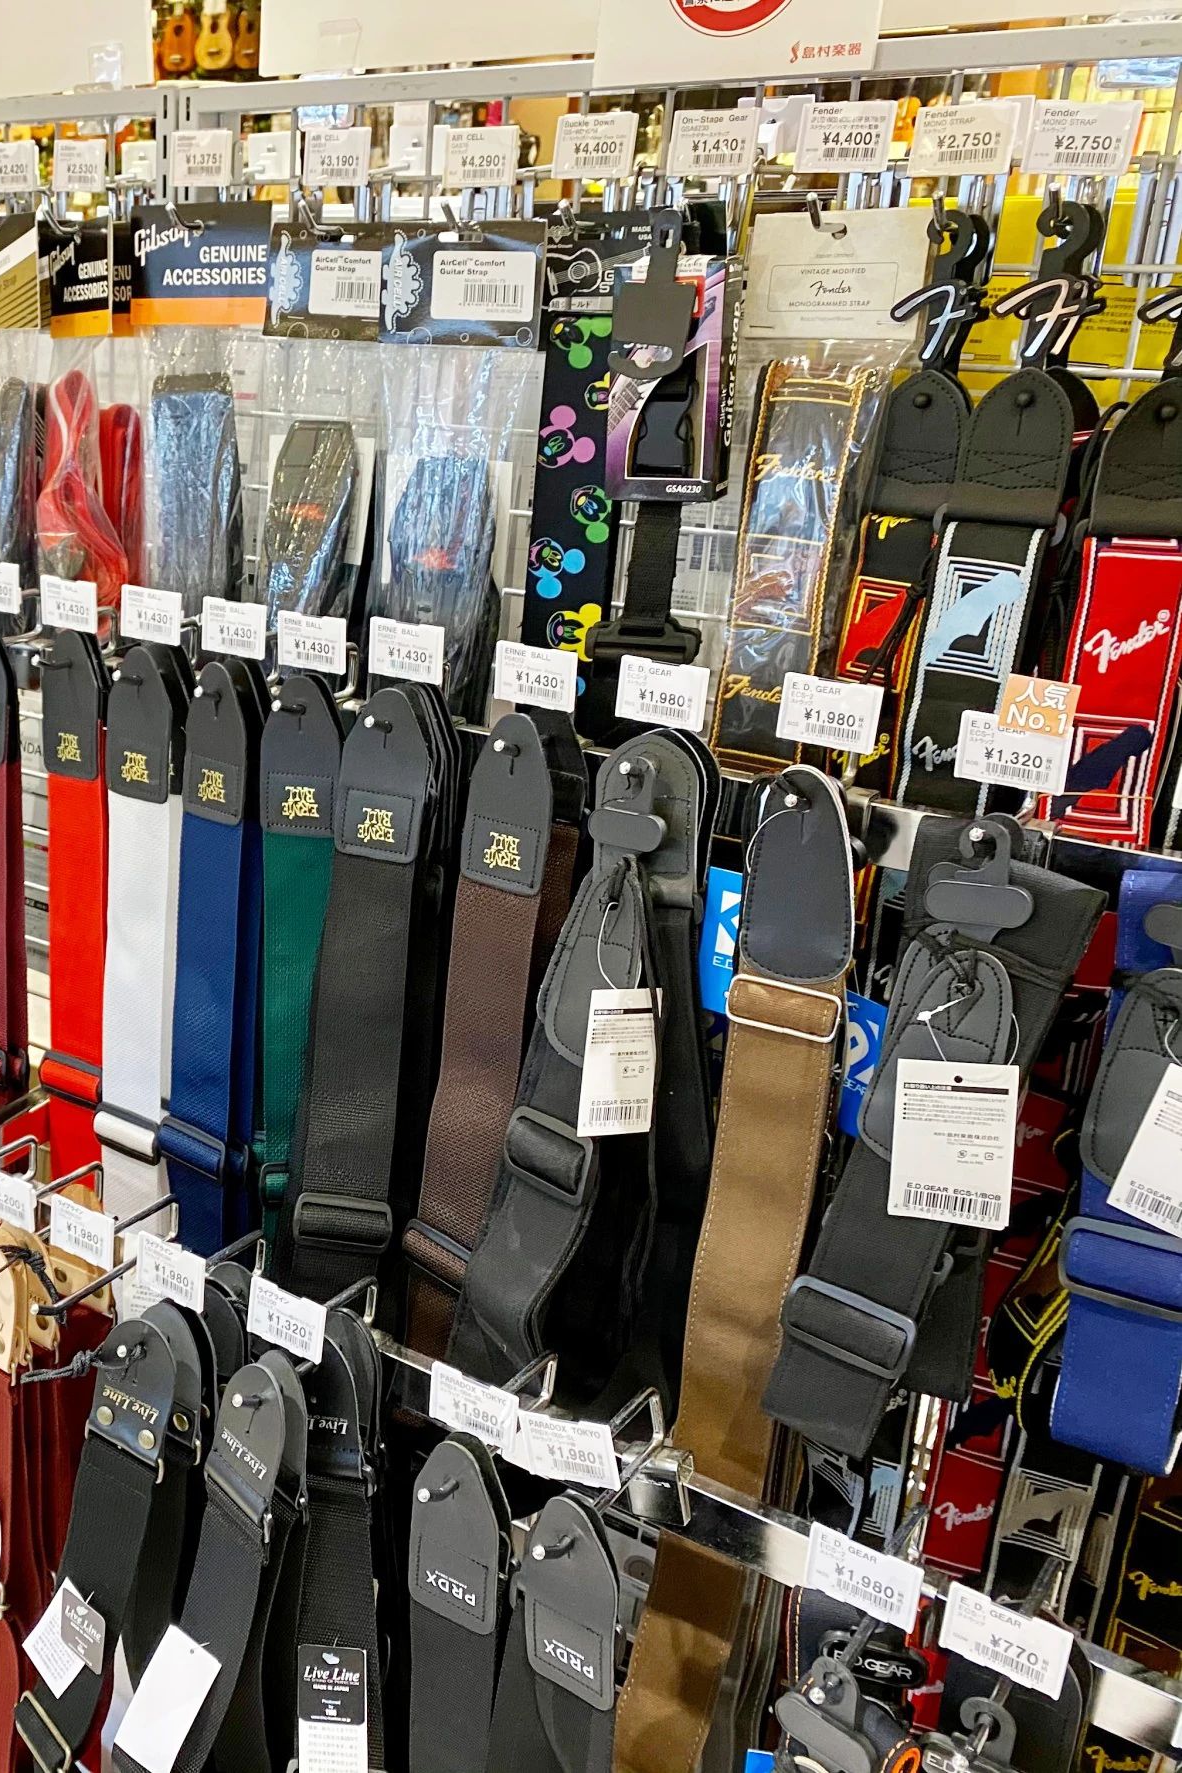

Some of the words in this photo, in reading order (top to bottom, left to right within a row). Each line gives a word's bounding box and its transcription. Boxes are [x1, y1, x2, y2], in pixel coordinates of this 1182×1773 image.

[802, 42, 862, 59] 島村楽器
[682, 115, 725, 125] On-Stage
[728, 113, 749, 123] Gear
[812, 106, 844, 115] Fender
[925, 109, 958, 119] Fender
[1045, 108, 1080, 117] Fender
[594, 118, 615, 128] Down
[691, 138, 739, 153] ¥1,430
[822, 131, 873, 146] ¥4,400
[937, 132, 993, 149] ¥2,750
[1054, 135, 1113, 150] ¥2,750
[574, 141, 618, 156] ¥4,400
[320, 154, 355, 167] ¥3,190
[461, 155, 501, 168] ¥4,290
[631, 225, 651, 234] MADE
[638, 233, 653, 241] USA
[133, 223, 191, 267] Gibson
[199, 245, 268, 263] GENUINE
[48, 240, 76, 285] Gibson
[78, 258, 108, 279] GENUINE
[315, 265, 336, 273] Guitar
[337, 266, 356, 274] Strap
[344, 257, 372, 265] Comfort
[474, 259, 506, 267] Comfort
[162, 267, 267, 286] ACCESSORIES
[440, 268, 466, 276] Guitar
[467, 268, 489, 277] Strap
[800, 267, 830, 275] VINTAGE
[831, 266, 867, 275] MODIFIED
[63, 281, 109, 303] ACCESSORIES
[810, 279, 852, 296] Fender
[788, 299, 847, 308] MONOGRAMMED
[848, 299, 871, 307] STRAP
[724, 374, 736, 447] Guitar
[730, 300, 742, 368] Strap
[665, 484, 702, 494] GSA6230
[56, 601, 85, 614] ¥1,430
[137, 608, 168, 625] ¥1,430
[219, 624, 252, 640] ¥1,430
[306, 620, 323, 630] BALL
[378, 624, 399, 634] ERNIE
[401, 628, 420, 638] BALL
[294, 638, 330, 655] ¥1,430
[388, 646, 427, 664] ¥1,430
[504, 646, 527, 658] ERNIE
[530, 650, 552, 662] BALL
[1083, 619, 1171, 674] Fender
[516, 670, 559, 688] ¥1,430
[648, 666, 672, 677] GEAR
[639, 687, 686, 708] ¥1,980
[816, 685, 841, 696] GEAR
[1015, 679, 1071, 711] 人気
[804, 708, 856, 728] ¥1,980
[1006, 702, 1068, 735] No.1
[123, 751, 148, 769] BALL
[984, 746, 1044, 770] ¥1,320
[120, 765, 150, 784] ERNIE
[201, 768, 224, 788] BALL
[197, 783, 226, 803] ERNIE
[284, 785, 316, 803] BALL
[281, 800, 320, 820] ERNIE
[362, 806, 394, 828] BALL
[356, 823, 395, 844] ERNIE
[489, 831, 521, 853] BALL
[483, 847, 522, 872] ERNIE
[906, 1182, 949, 1194] E.D.GEAR
[953, 1188, 1002, 1202] ECS-1/BOB
[1129, 1180, 1172, 1204] E.D.GEAR
[65, 1221, 99, 1246] ¥1,980
[154, 1261, 189, 1288] ¥1,980
[266, 1311, 307, 1338] ¥1,320
[102, 1386, 134, 1409] Line
[132, 1400, 161, 1426] Live
[452, 1398, 499, 1427] ¥1,980
[318, 1418, 349, 1436] Live
[528, 1419, 567, 1433] PARADOX
[572, 1426, 601, 1440] TOKYO
[220, 1428, 245, 1459] Line
[546, 1443, 596, 1465] ¥1,980
[242, 1449, 269, 1482] Live
[848, 1545, 878, 1565] GEAR
[425, 1569, 476, 1607] PRDX
[834, 1562, 895, 1600] ¥1,980
[65, 1604, 83, 1624] Live
[83, 1619, 102, 1641] Line
[989, 1608, 1023, 1630] GEAR
[543, 1638, 595, 1680] PRDX
[990, 1633, 1040, 1667] ¥770
[304, 1664, 331, 1680] Live
[332, 1667, 360, 1682] Line
